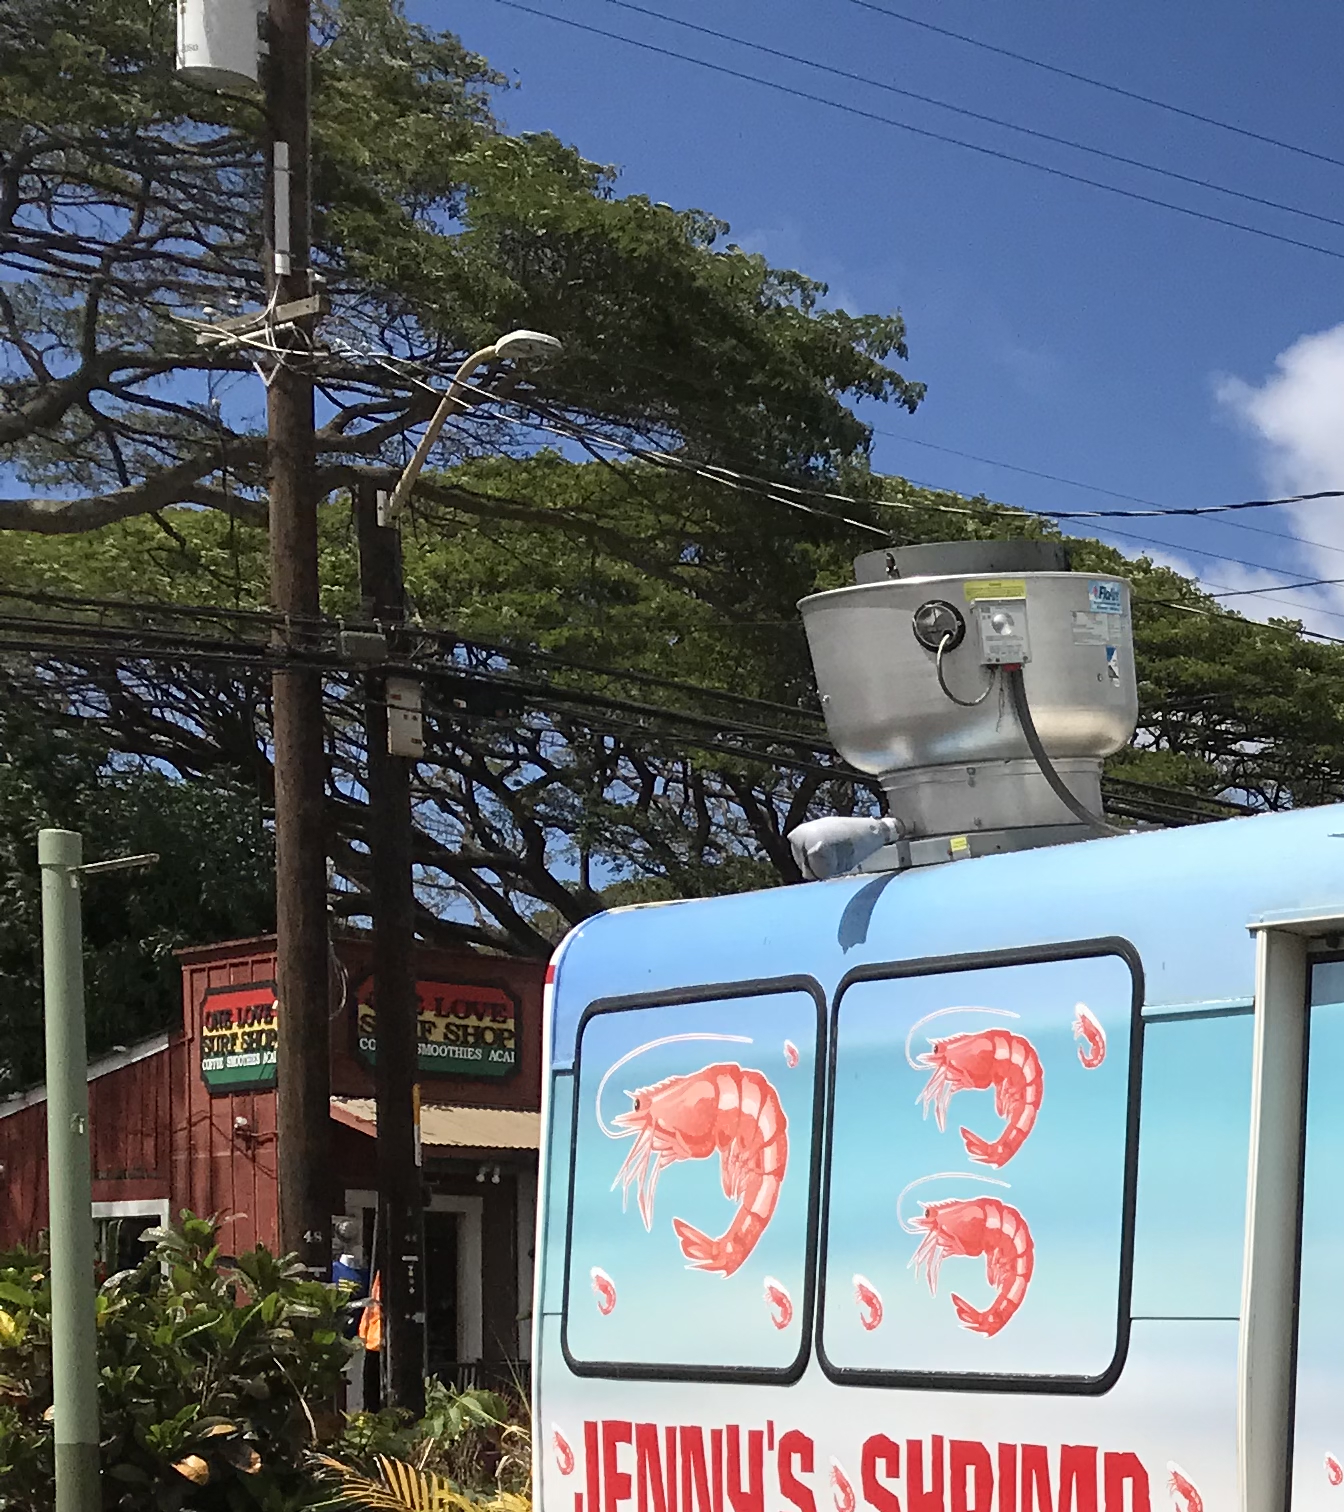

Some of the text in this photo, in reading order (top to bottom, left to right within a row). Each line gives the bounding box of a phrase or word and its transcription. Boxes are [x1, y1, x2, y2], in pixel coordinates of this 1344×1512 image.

[434, 997, 507, 1023] LOVE
[202, 1028, 278, 1056] SURF SHOP
[443, 1022, 515, 1049] SHOP
[488, 1050, 516, 1063] ACAI
